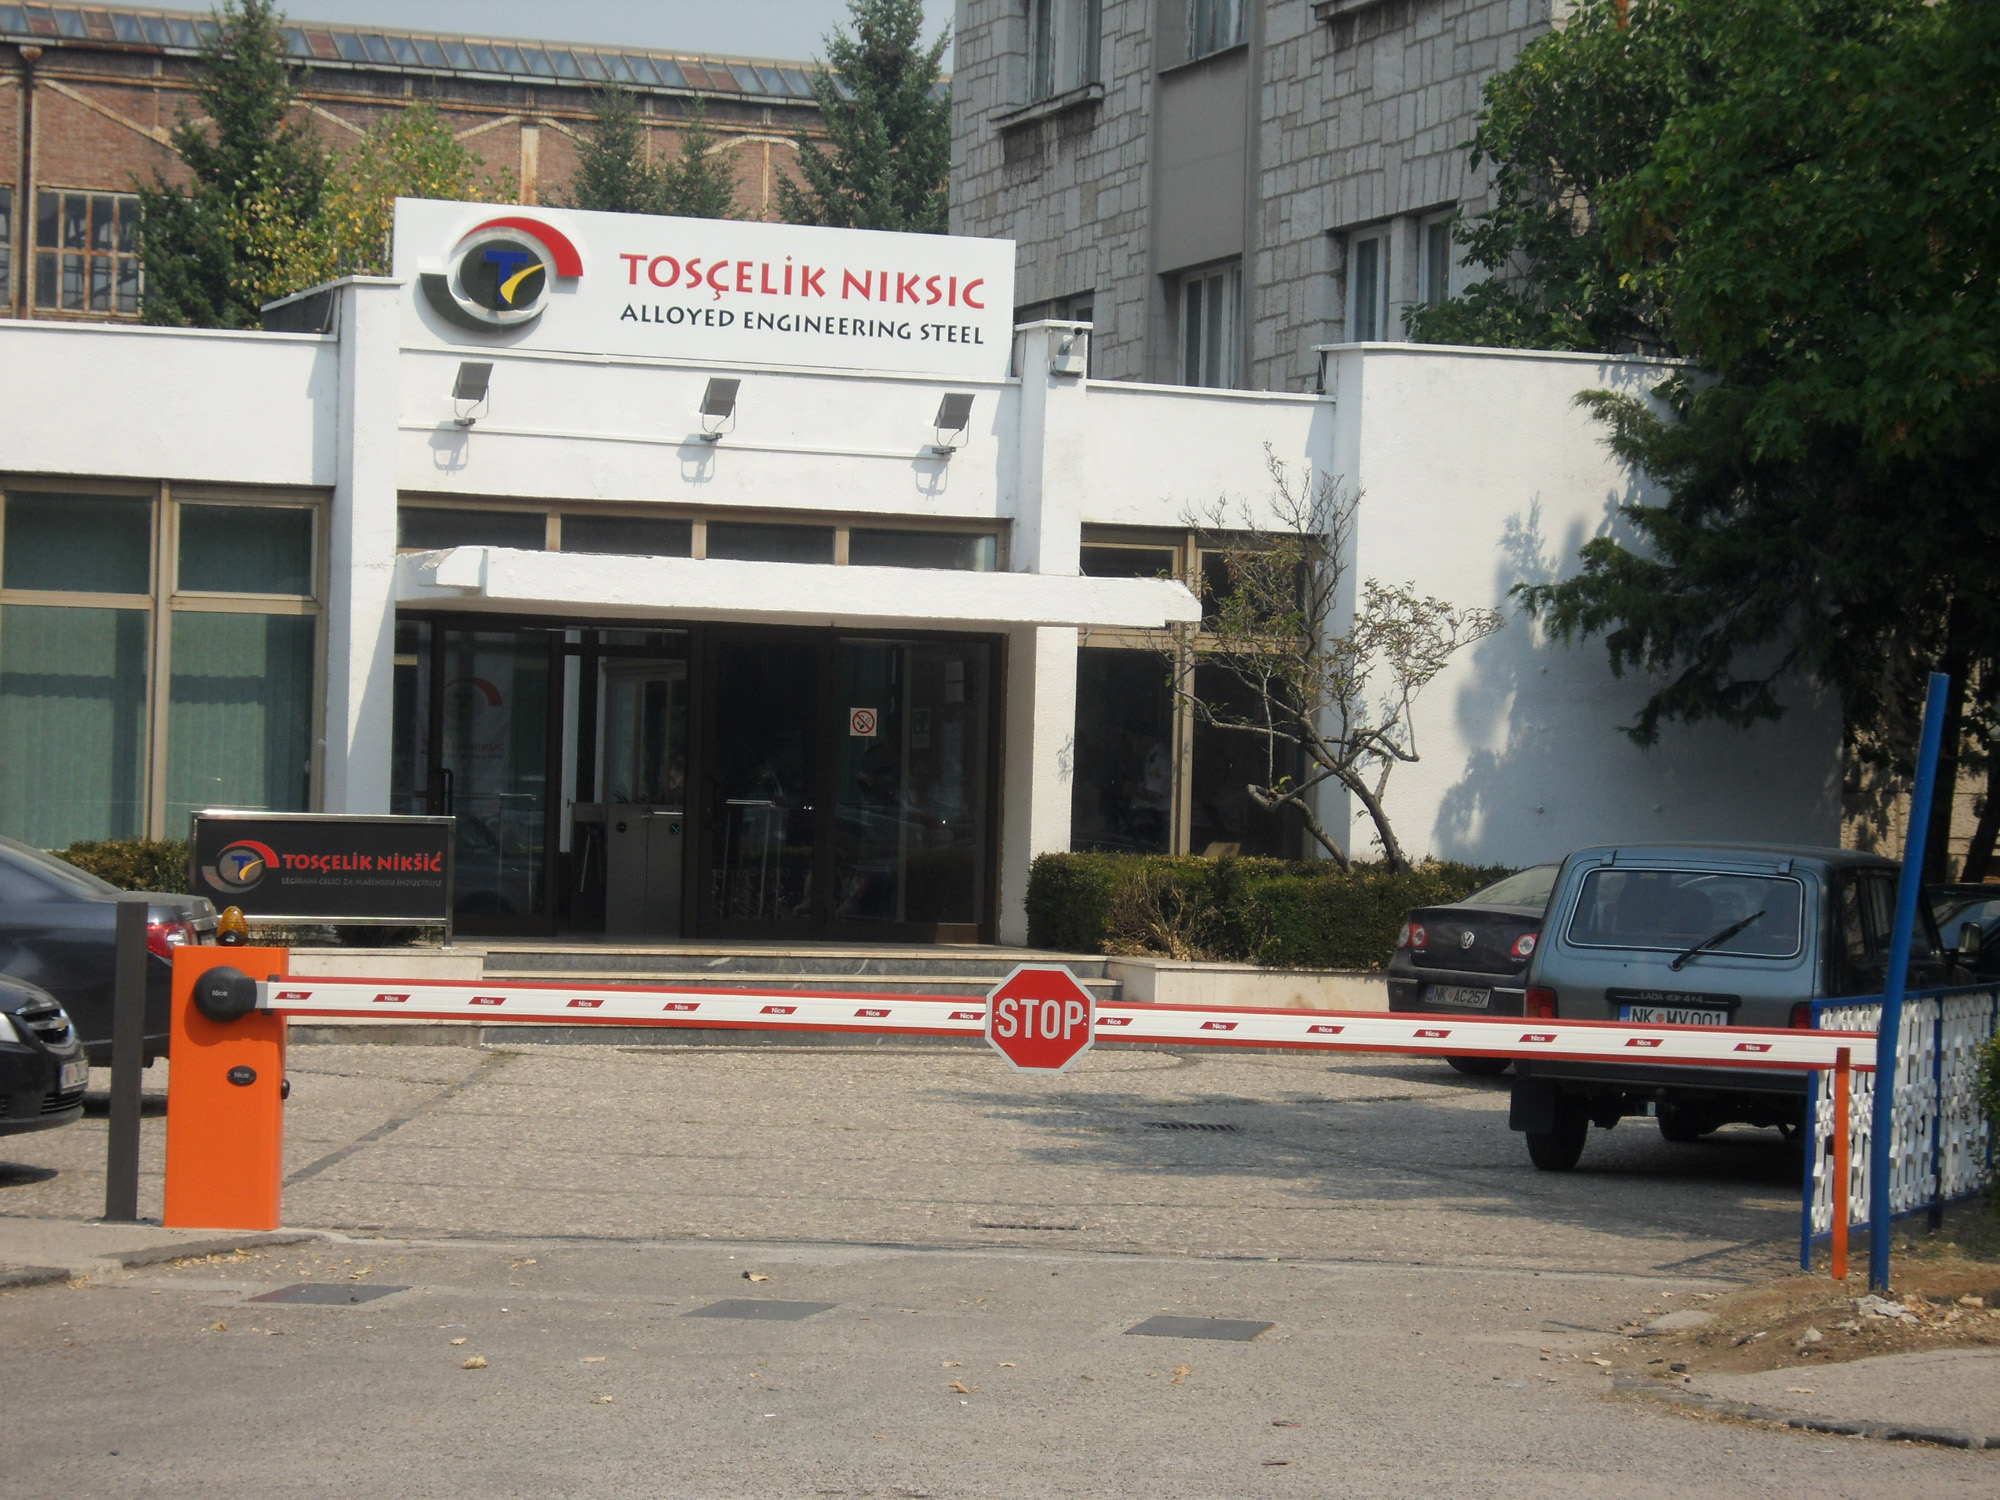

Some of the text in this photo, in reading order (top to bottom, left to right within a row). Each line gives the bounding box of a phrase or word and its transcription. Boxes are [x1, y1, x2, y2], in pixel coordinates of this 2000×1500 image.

[619, 253, 986, 310] TOSÇELİK NIKSIC
[619, 302, 985, 346] ALLOYED ENGINEERING STEEL
[282, 851, 372, 874] TOSÇELİK
[1434, 986, 1489, 1005] NK AC257
[1640, 992, 1664, 1001] LADA
[998, 998, 1084, 1040] STOP
[1632, 1008, 1654, 1023] NK
